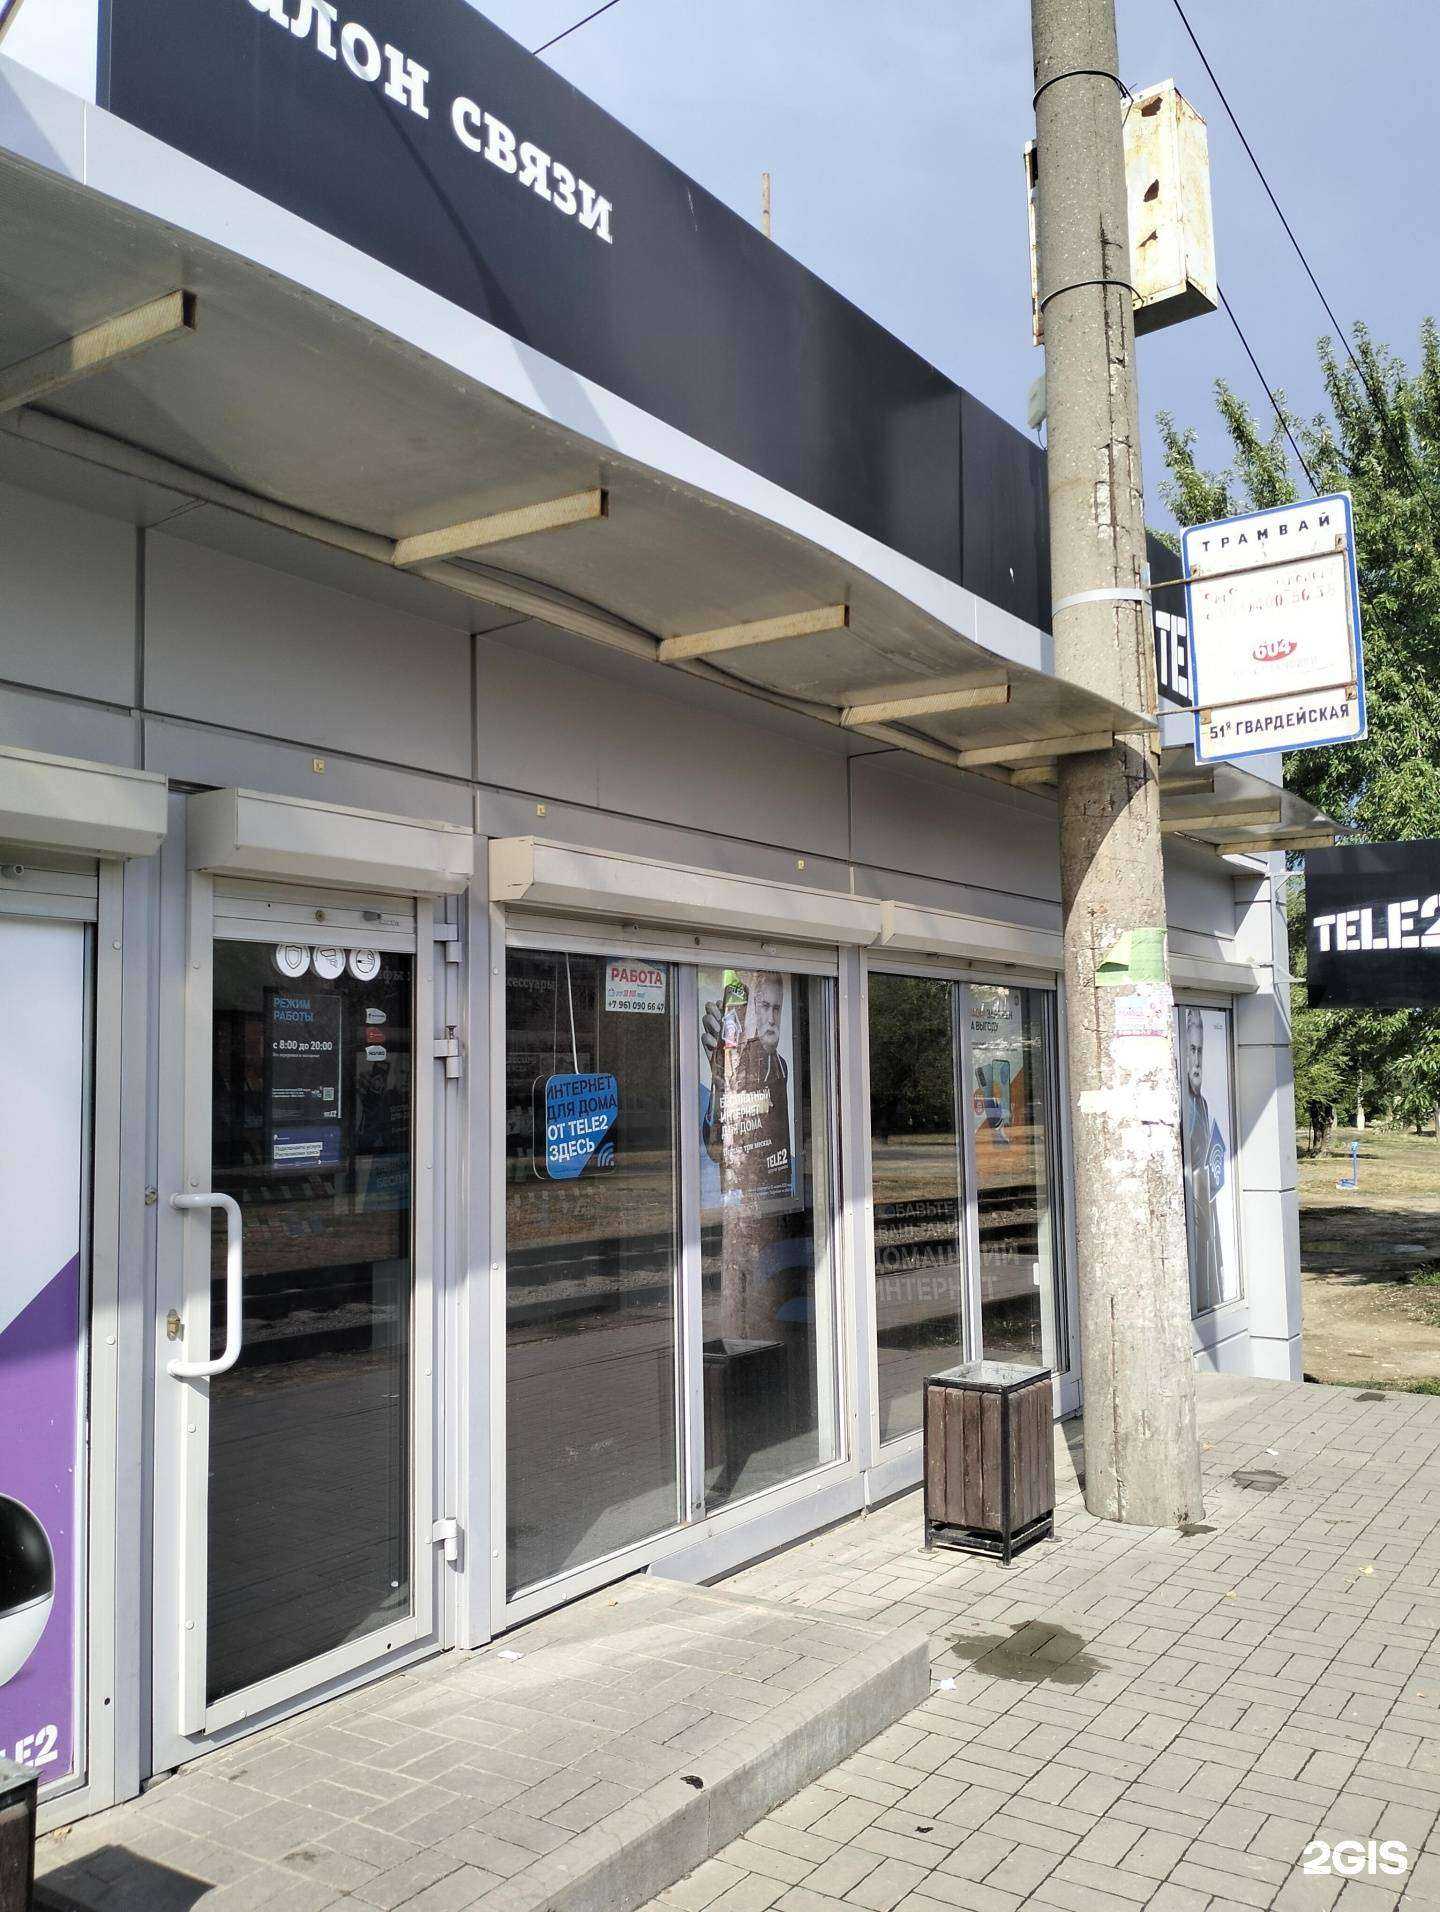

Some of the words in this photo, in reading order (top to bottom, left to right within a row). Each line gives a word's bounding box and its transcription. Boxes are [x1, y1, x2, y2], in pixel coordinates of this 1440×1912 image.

[1202, 512, 1331, 552] ТРАМВАЙ
[1236, 704, 1350, 736] ГВАРДЕЙСКАЯ
[611, 967, 662, 985] РАБОТА
[274, 997, 311, 1009] РЕЖИМ
[274, 1010, 314, 1022] РАБОТЫ
[279, 1040, 298, 1050] 8:00
[310, 1041, 333, 1050] 20:00
[578, 1094, 617, 1117] ДОМА
[548, 1122, 566, 1140] ОТ
[567, 1114, 608, 1136] TELE2
[740, 1117, 763, 1135] ДОМА
[549, 1137, 595, 1163] ЗДЕСЬ
[767, 1148, 788, 1168] TELE2
[0, 1724, 58, 1767] E2
